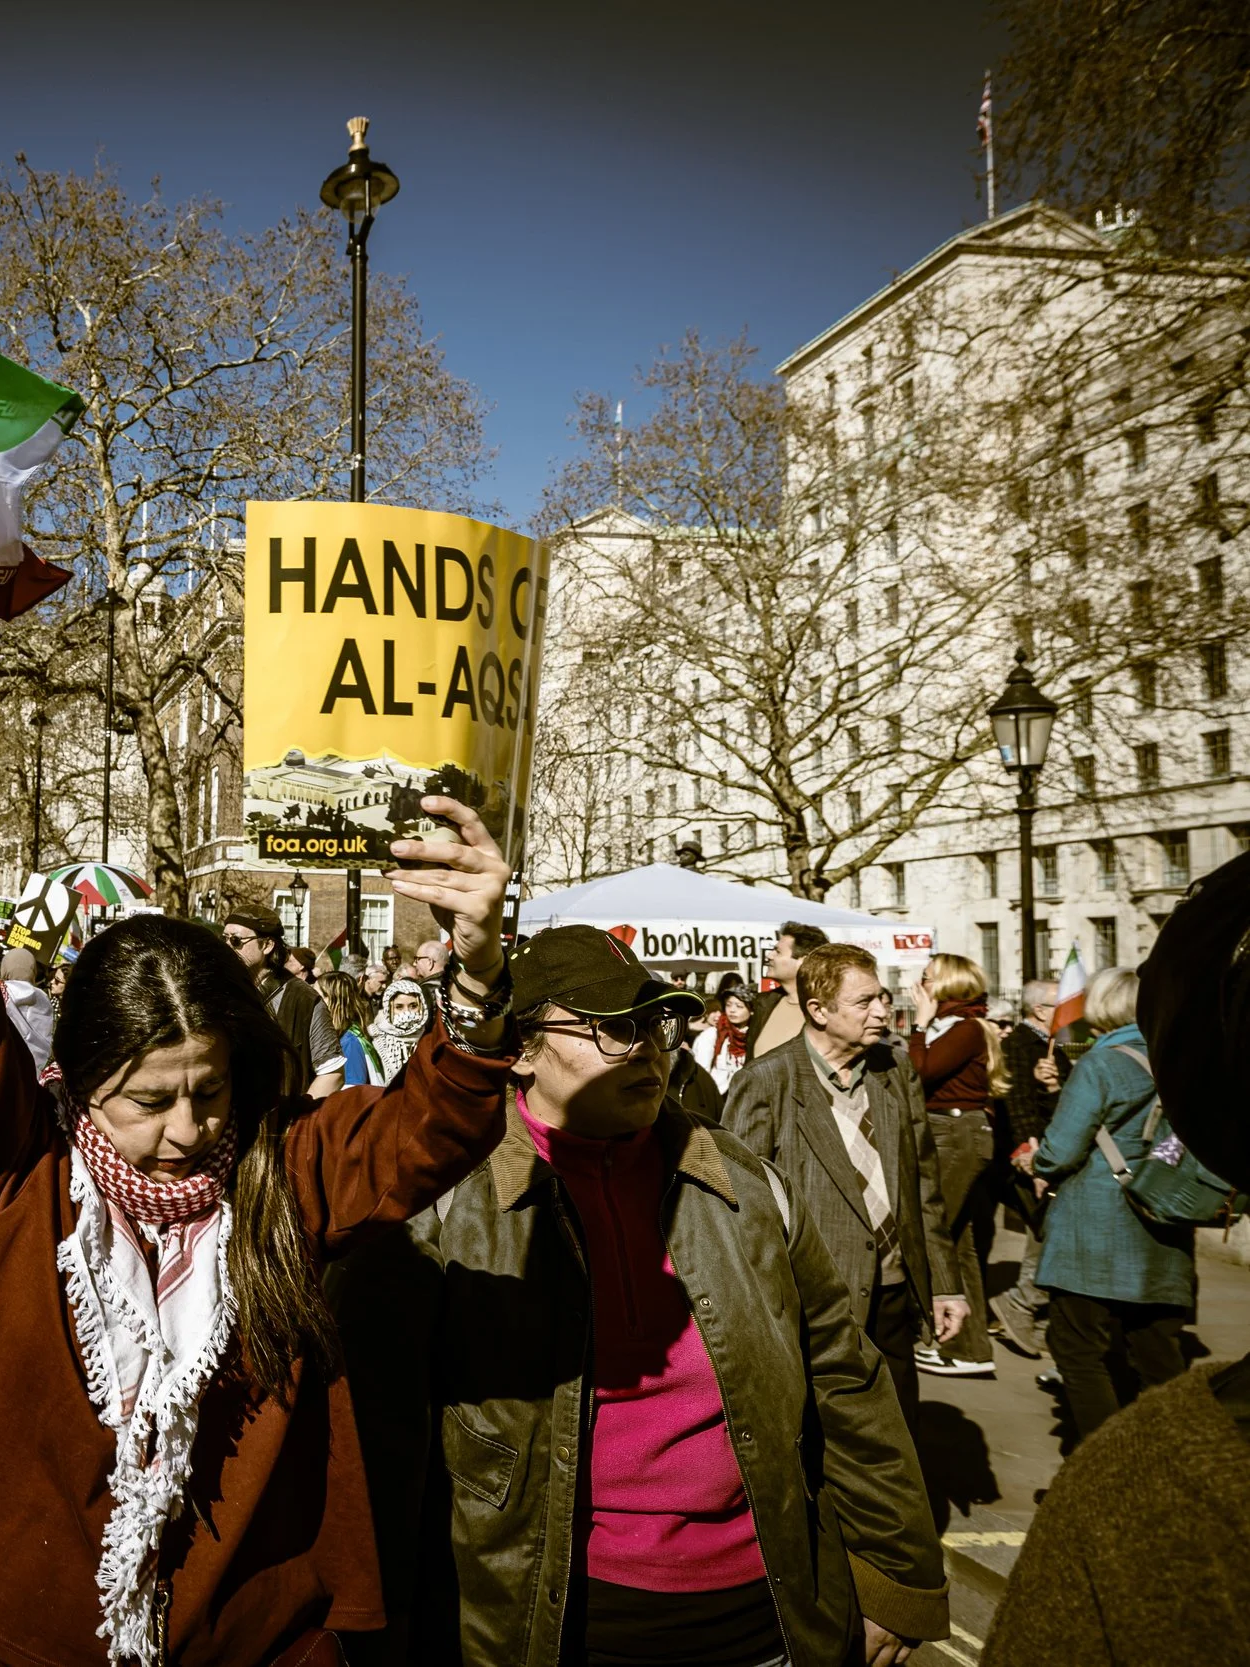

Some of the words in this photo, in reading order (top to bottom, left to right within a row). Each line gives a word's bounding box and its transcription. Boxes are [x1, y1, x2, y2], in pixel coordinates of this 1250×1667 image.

[269, 537, 495, 630] HANDS
[319, 638, 532, 735] AL-AQS
[266, 834, 368, 857] foa.org.uk
[13, 923, 32, 936] STOP
[896, 935, 931, 949] TUC
